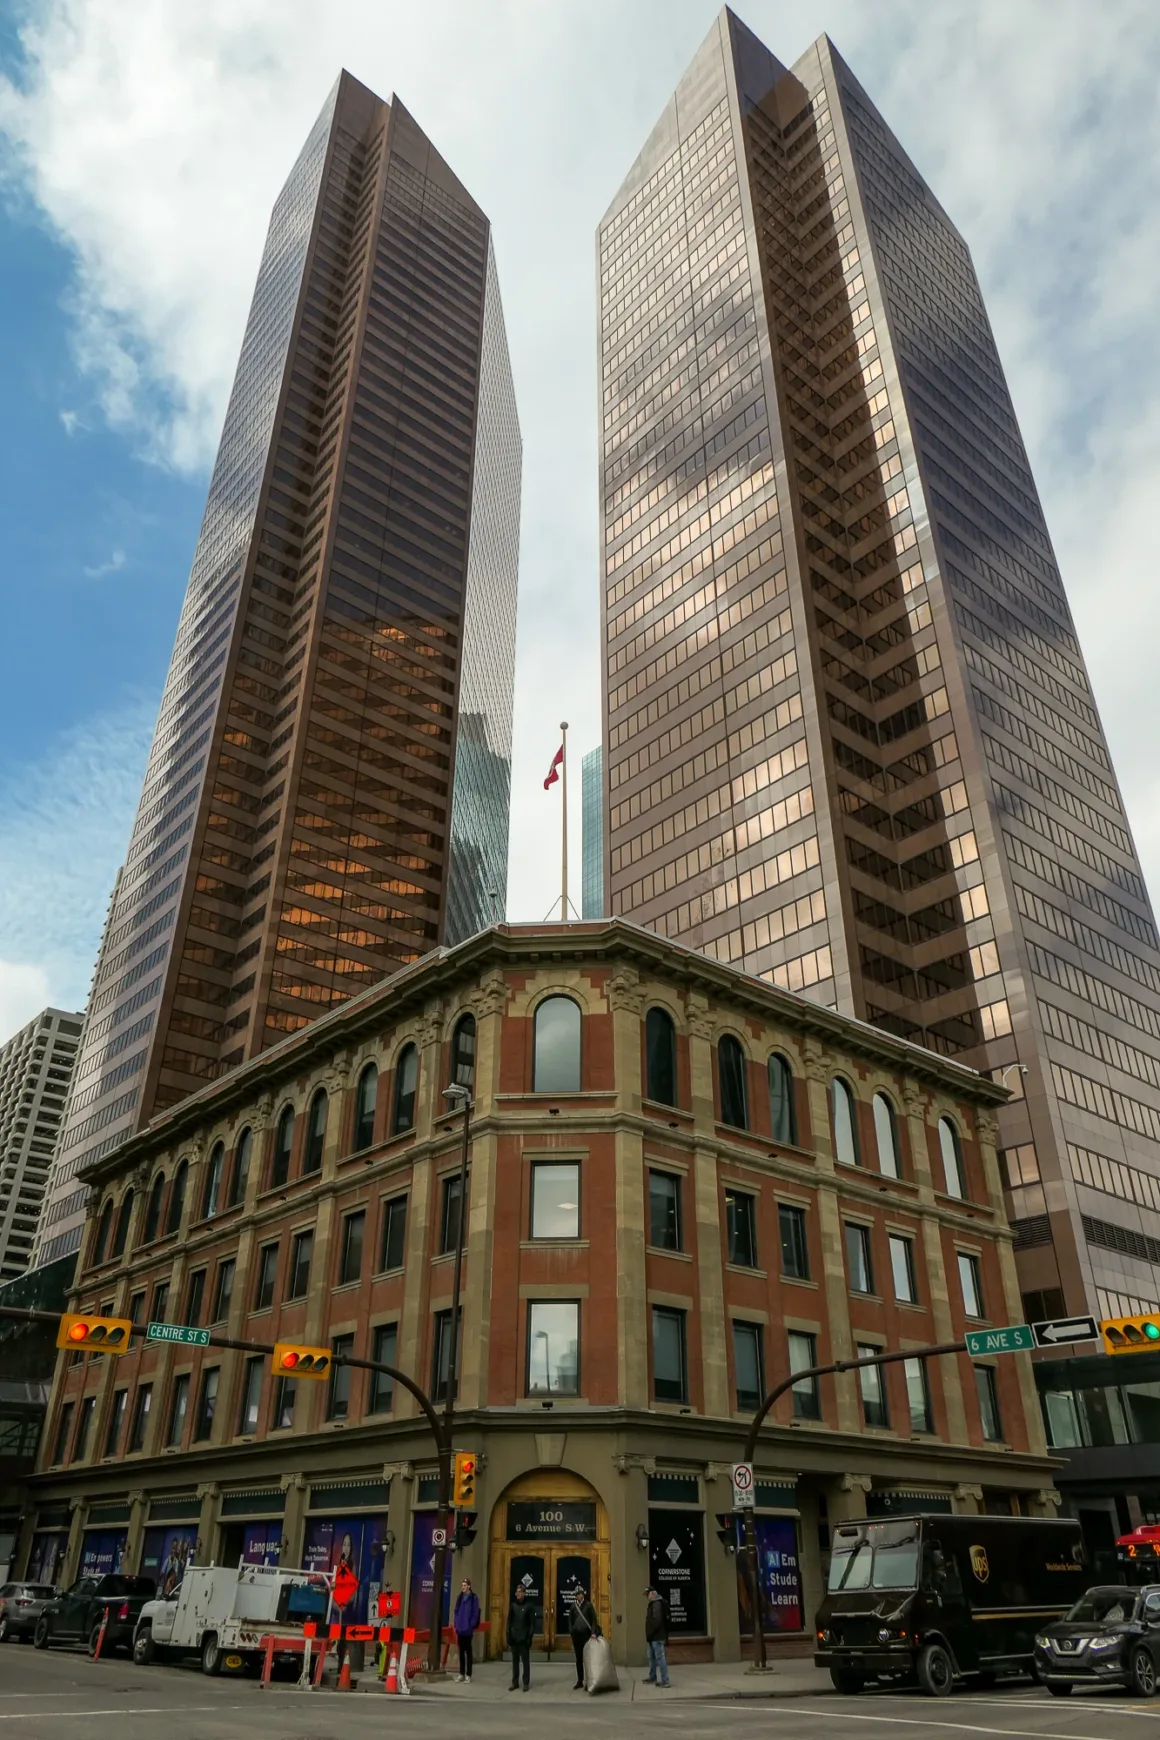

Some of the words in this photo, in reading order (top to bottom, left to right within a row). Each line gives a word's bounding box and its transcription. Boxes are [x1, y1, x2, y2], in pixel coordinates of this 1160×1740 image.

[150, 1325, 185, 1340] CENTRE
[187, 1330, 199, 1342] ST
[200, 1332, 207, 1343] S
[971, 1338, 979, 1351] 6
[986, 1333, 1009, 1349] AVE
[1013, 1331, 1023, 1345] S
[539, 1511, 564, 1522] 100
[515, 1523, 522, 1532] 6
[525, 1523, 561, 1532] Avenue
[1128, 1544, 1137, 1557] 2
[781, 1553, 796, 1567] Em
[770, 1572, 797, 1586] Stude
[771, 1591, 798, 1605] Learn
